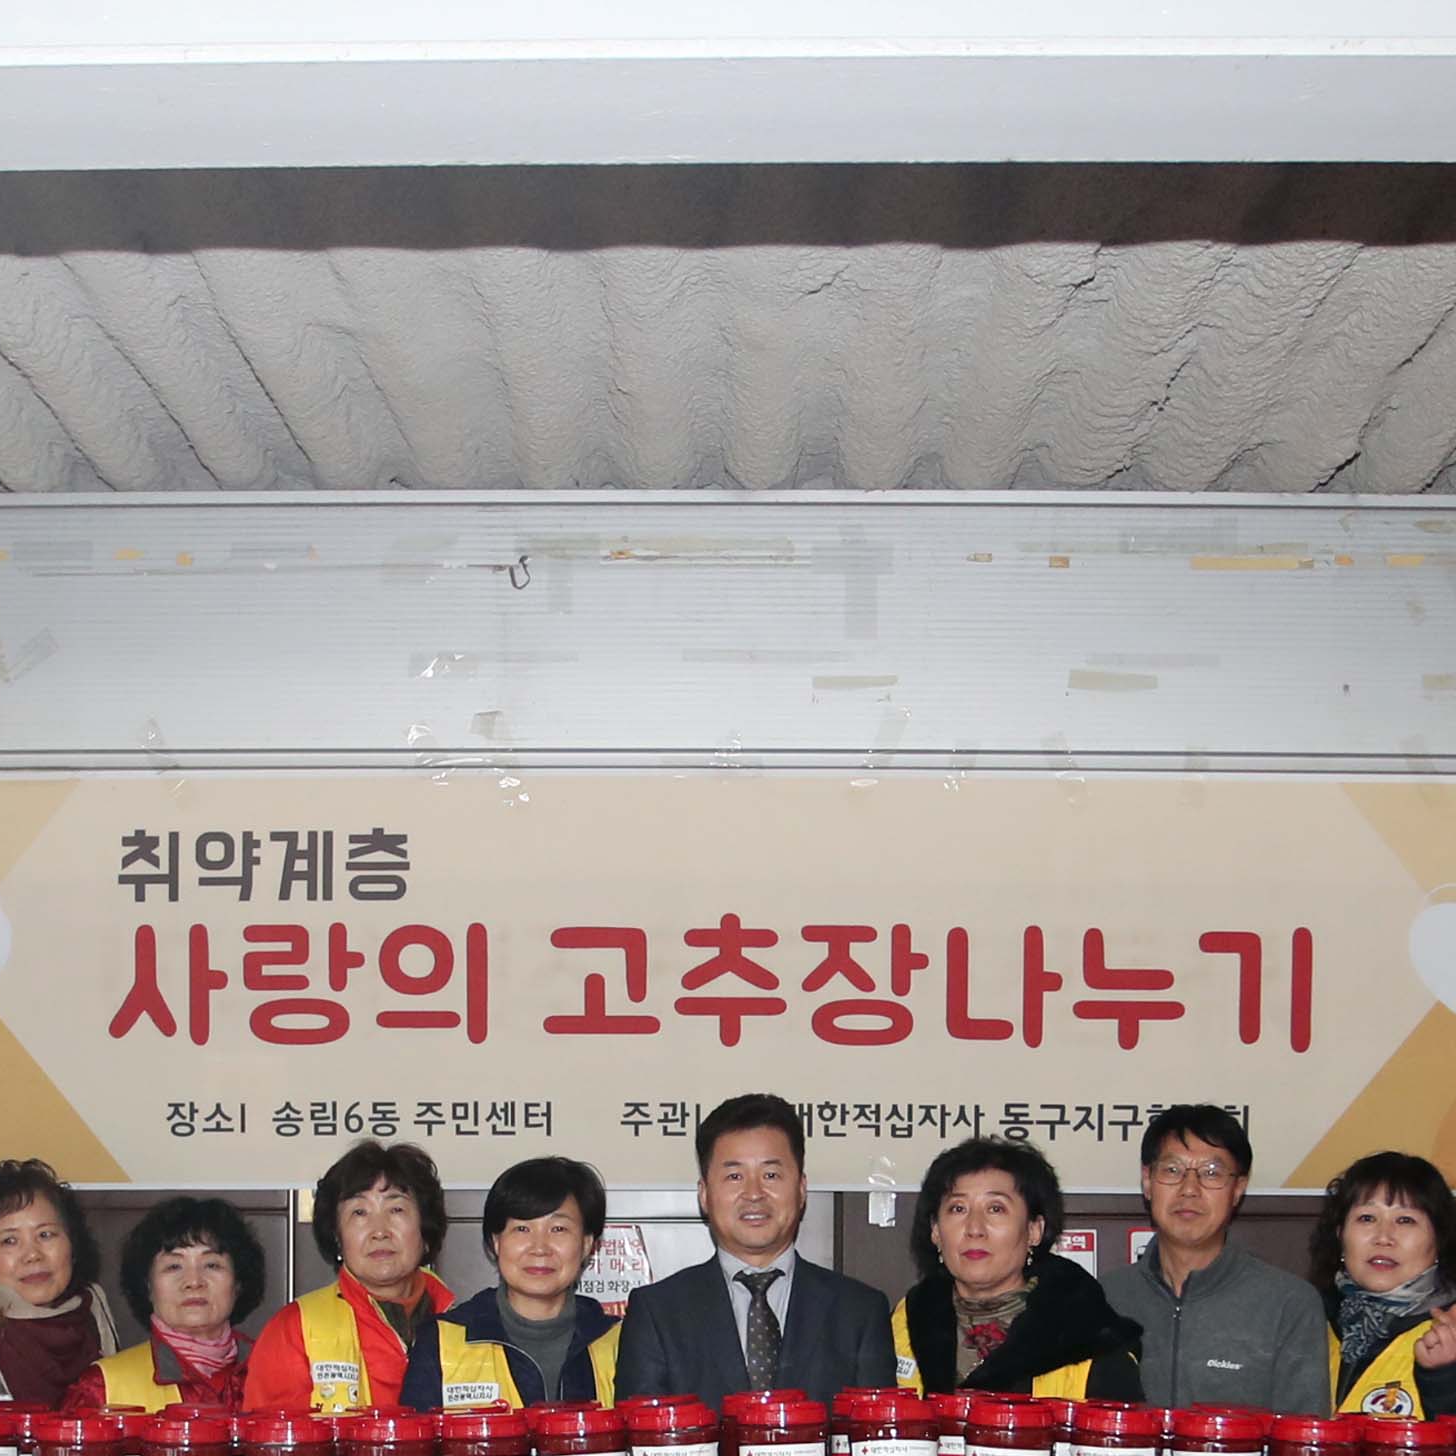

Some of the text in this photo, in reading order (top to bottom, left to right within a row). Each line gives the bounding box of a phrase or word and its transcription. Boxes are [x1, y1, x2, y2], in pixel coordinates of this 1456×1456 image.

[118, 827, 410, 902] 취약계층
[108, 913, 1312, 1053] 사랑의 고추장나누기
[272, 1100, 400, 1137] 송림6동
[414, 1100, 552, 1137] 주민센터
